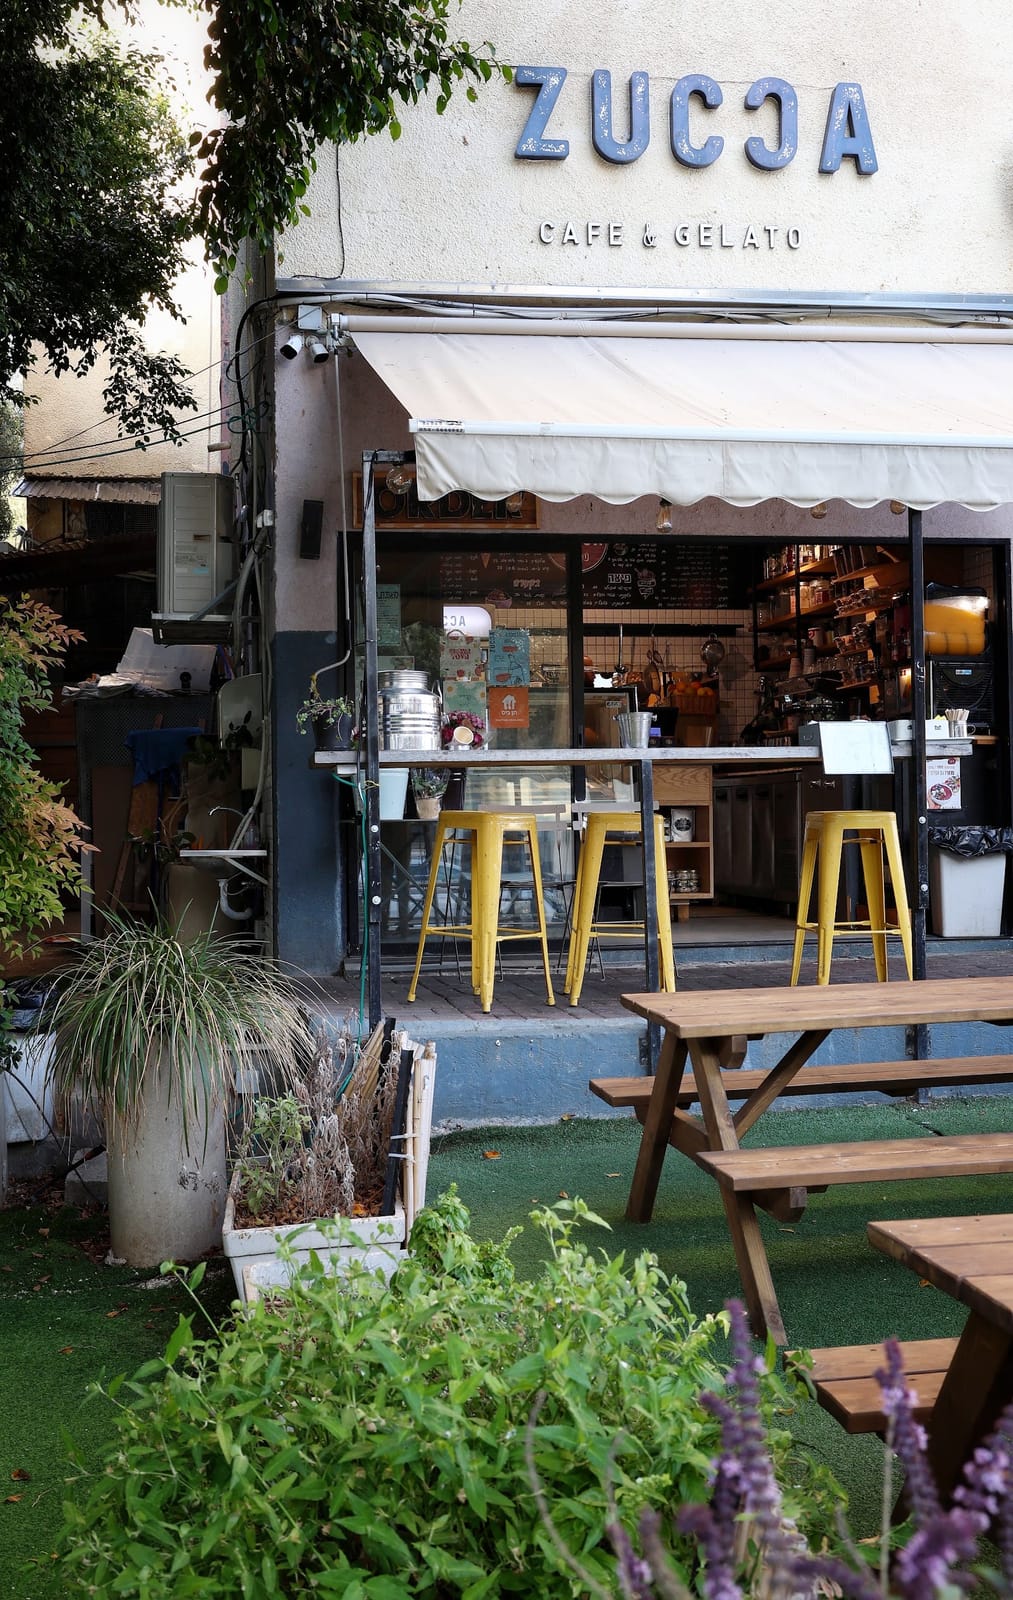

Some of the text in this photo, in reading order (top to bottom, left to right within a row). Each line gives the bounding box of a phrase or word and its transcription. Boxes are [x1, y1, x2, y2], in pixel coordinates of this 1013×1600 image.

[514, 65, 879, 175] ZUCCA
[539, 221, 804, 250] CAFE & GELATO
